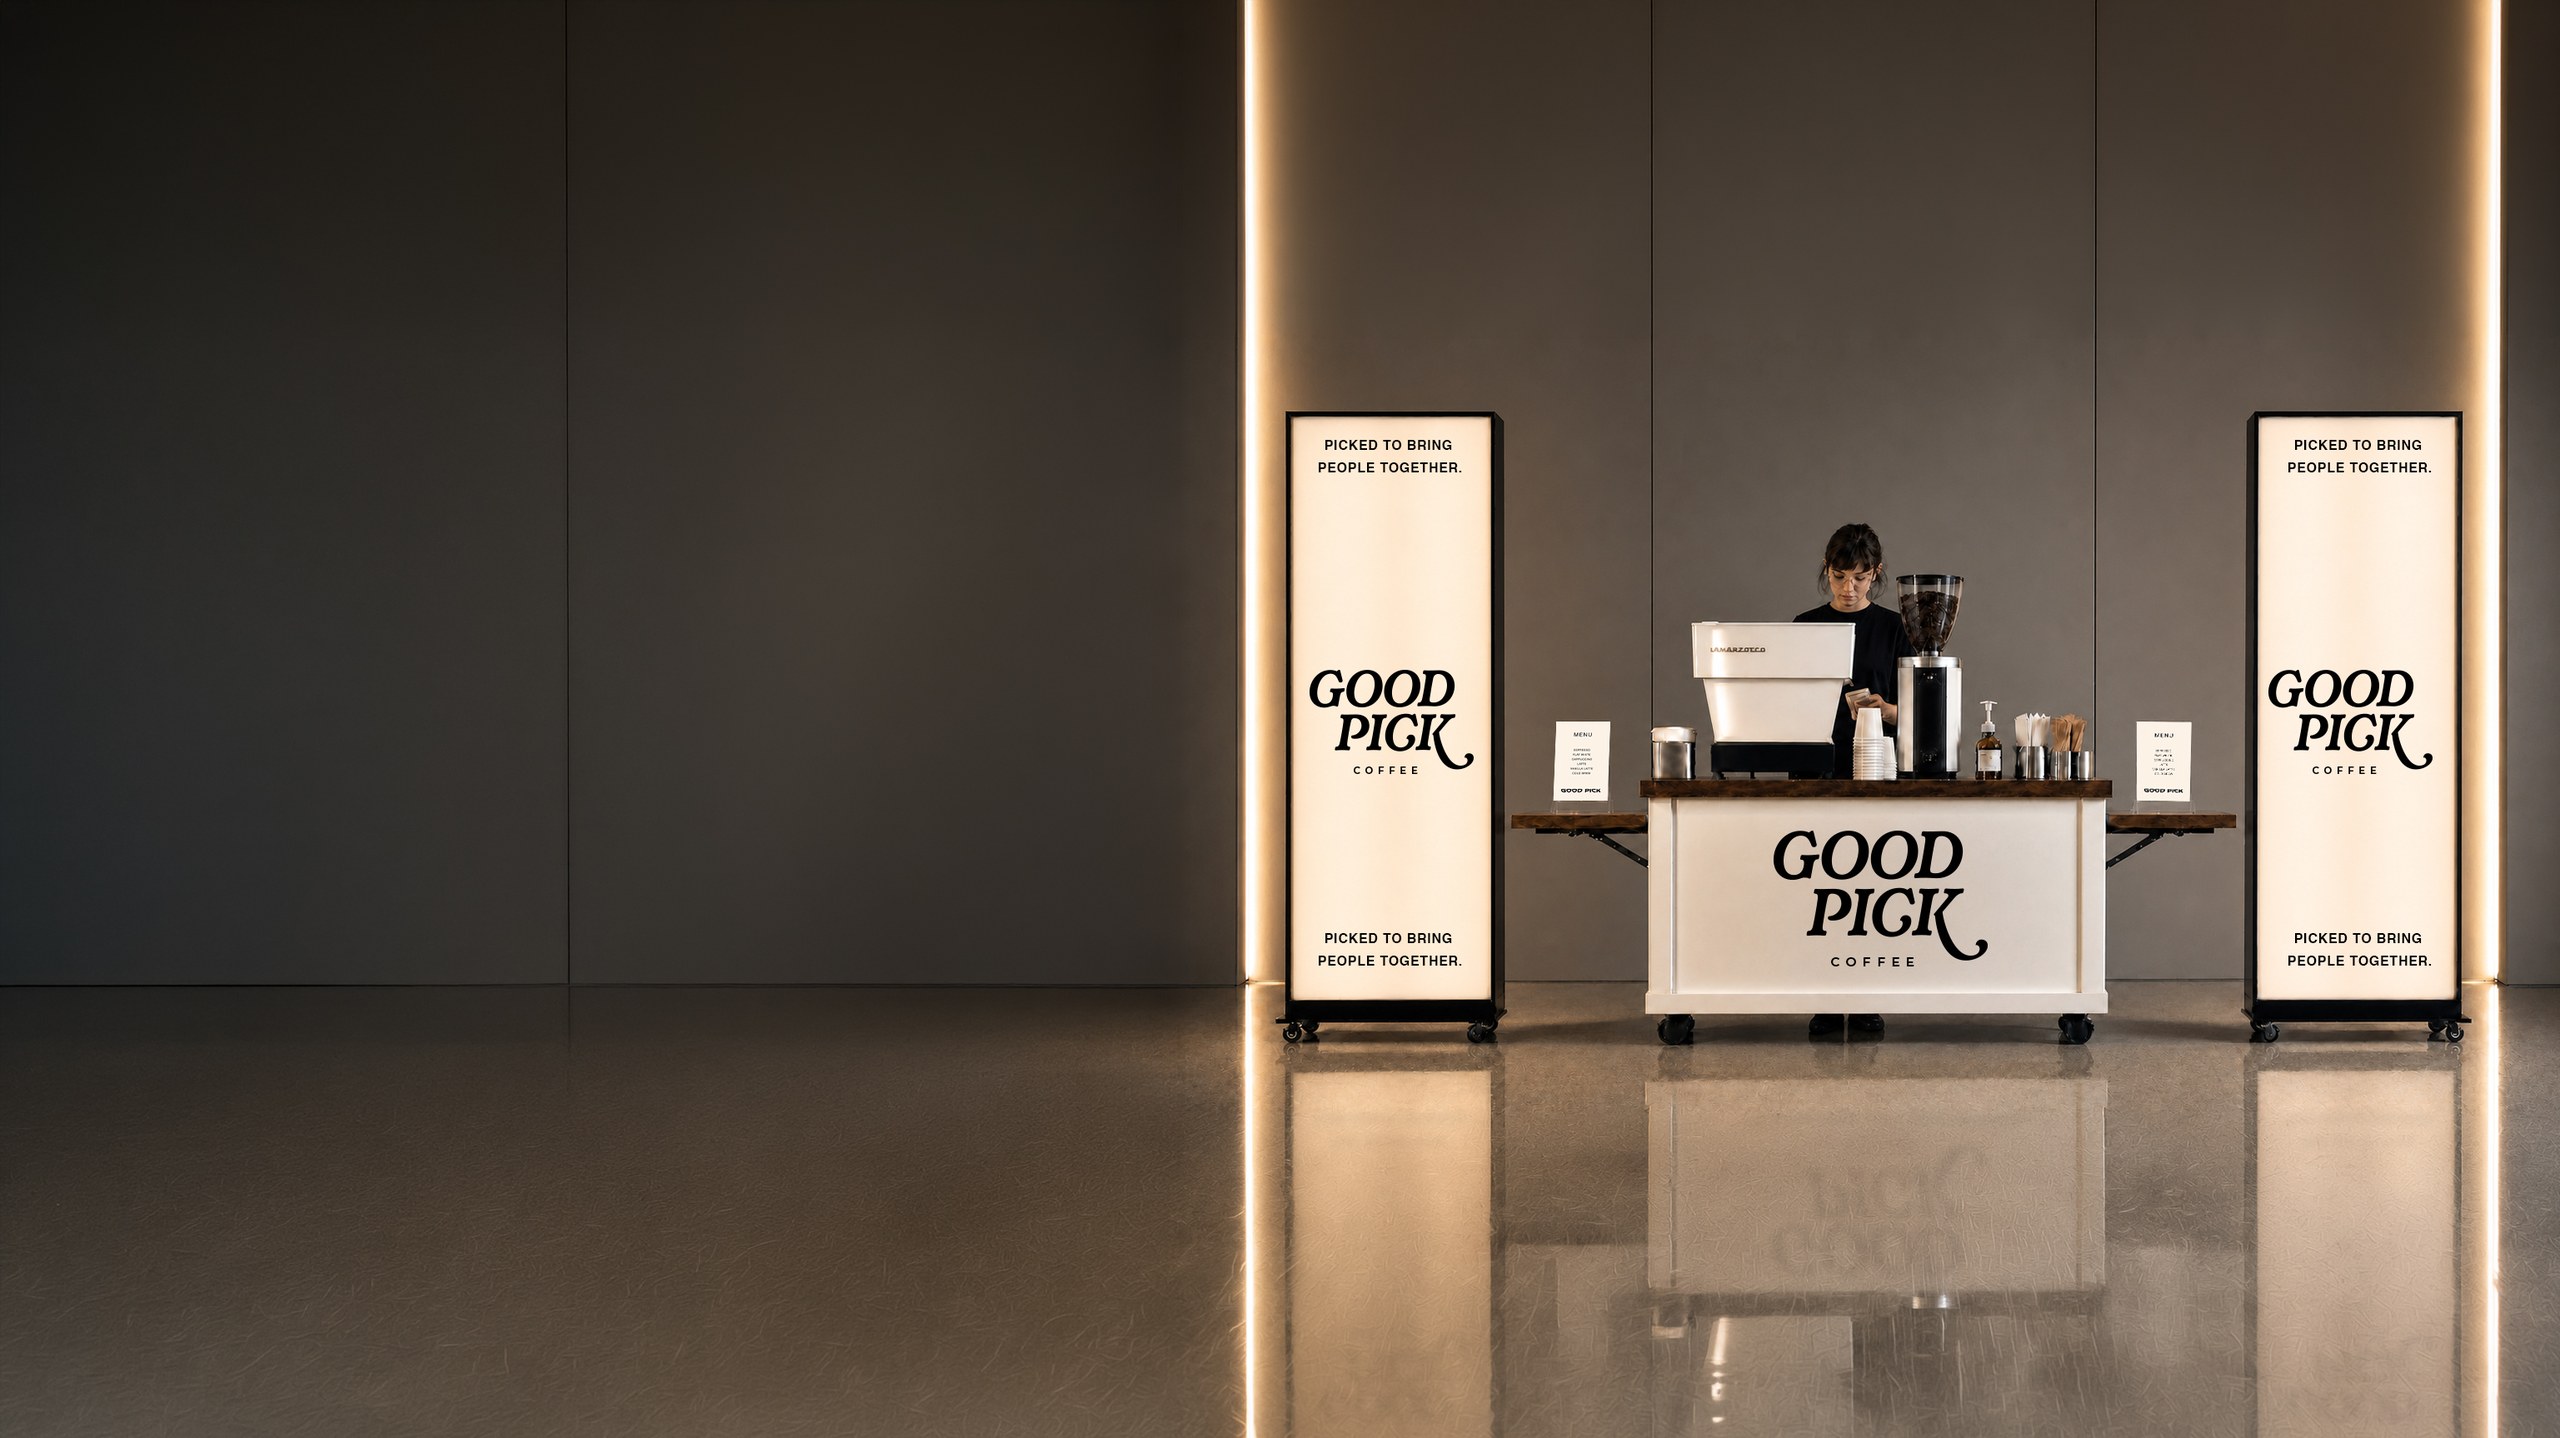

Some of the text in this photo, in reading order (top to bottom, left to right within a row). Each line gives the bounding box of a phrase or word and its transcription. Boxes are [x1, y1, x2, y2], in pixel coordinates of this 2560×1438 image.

[1324, 439, 1452, 451] PICKED TO BRING
[2294, 439, 2422, 451] PICKED TO BRING
[1318, 461, 1462, 474] PEOPLE TOGETHER.
[2287, 461, 2432, 474] PEOPLE TOGETHER.
[1309, 669, 1456, 709] GOOD
[2267, 669, 2414, 709] GOOD
[1334, 713, 1475, 770] PICK
[2293, 713, 2434, 770] PICK
[1353, 765, 1419, 775] COFFEE
[2312, 765, 2378, 775] COFFEE
[1772, 830, 1964, 881] GOOD
[1806, 887, 1989, 962] PICK
[1324, 932, 1452, 944] PICKED TO BRING
[2294, 932, 2422, 944] PICKED TO BRING
[1318, 954, 1462, 967] PEOPLE TOGETHER.
[1830, 956, 1916, 968] COFFEE
[2287, 954, 2432, 967] PEOPLE TOGETHER.
